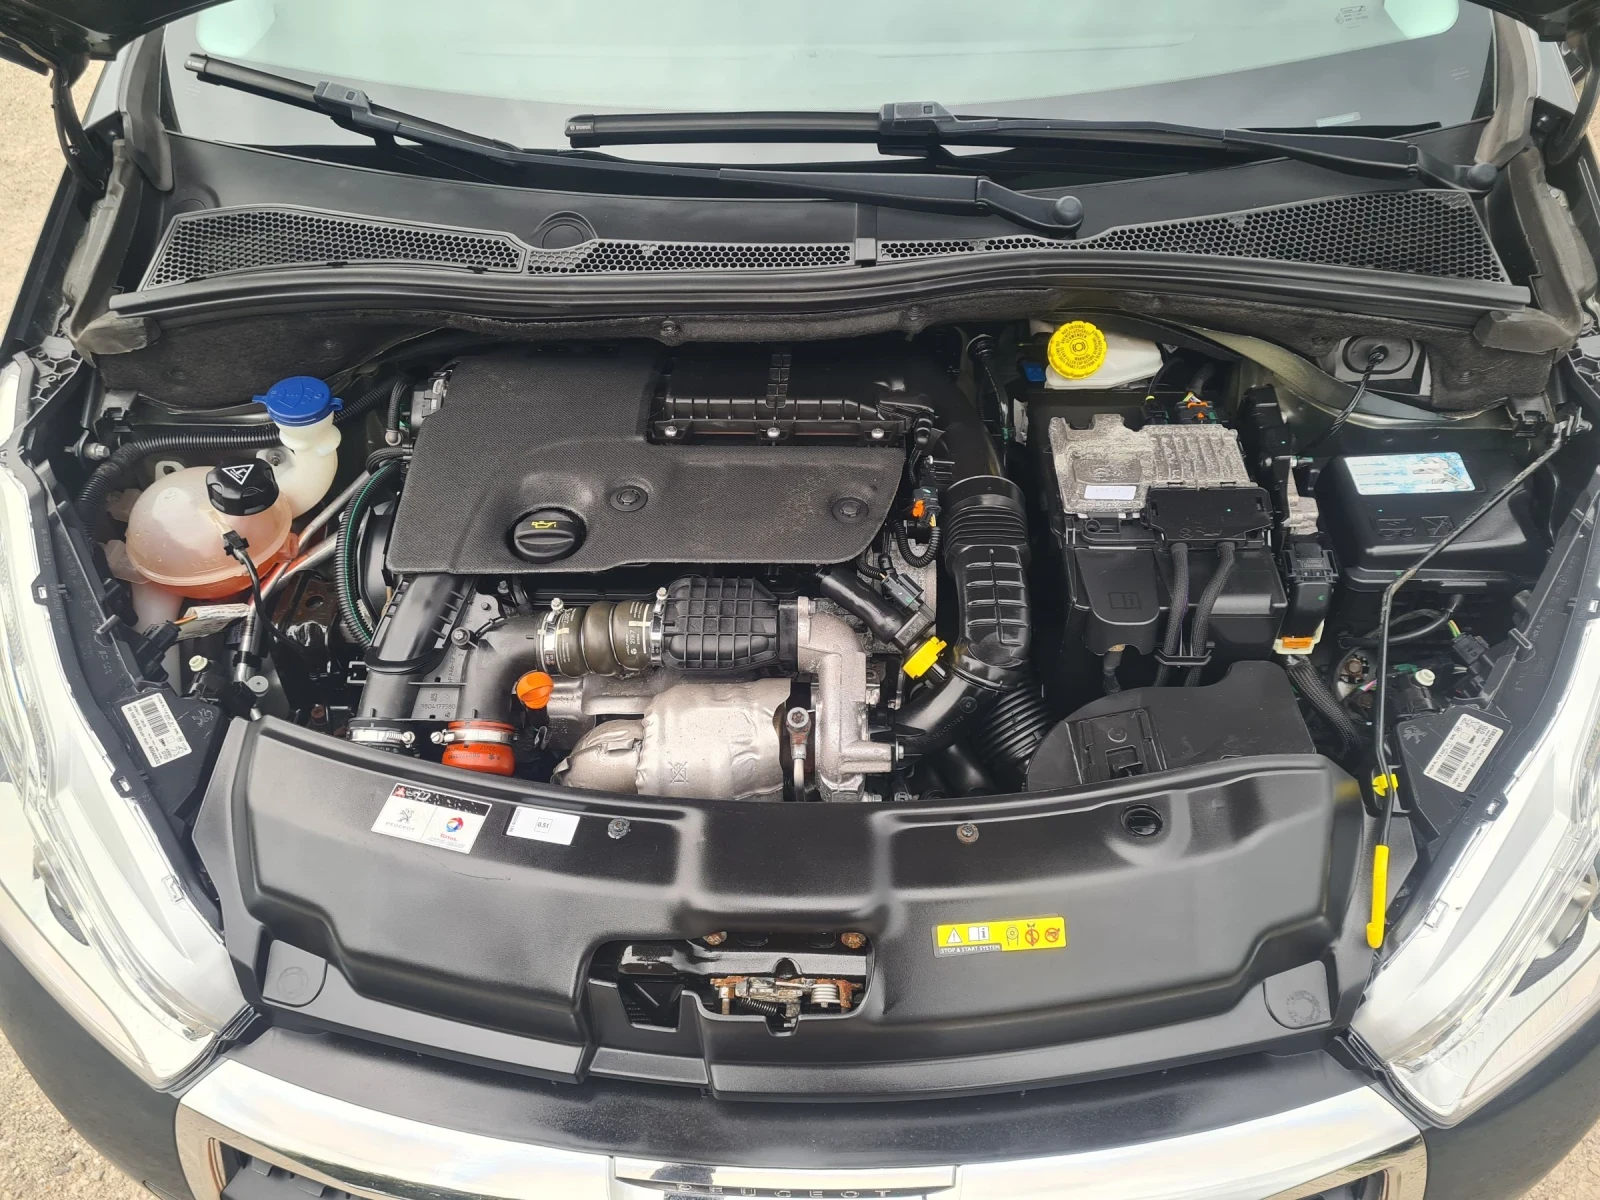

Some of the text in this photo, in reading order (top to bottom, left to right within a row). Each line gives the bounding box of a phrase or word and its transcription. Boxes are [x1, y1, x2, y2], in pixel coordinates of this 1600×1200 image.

[385, 821, 416, 832] PEUGEOT
[440, 833, 457, 841] TOTAL
[676, 1183, 892, 1198] PEUGEOT
